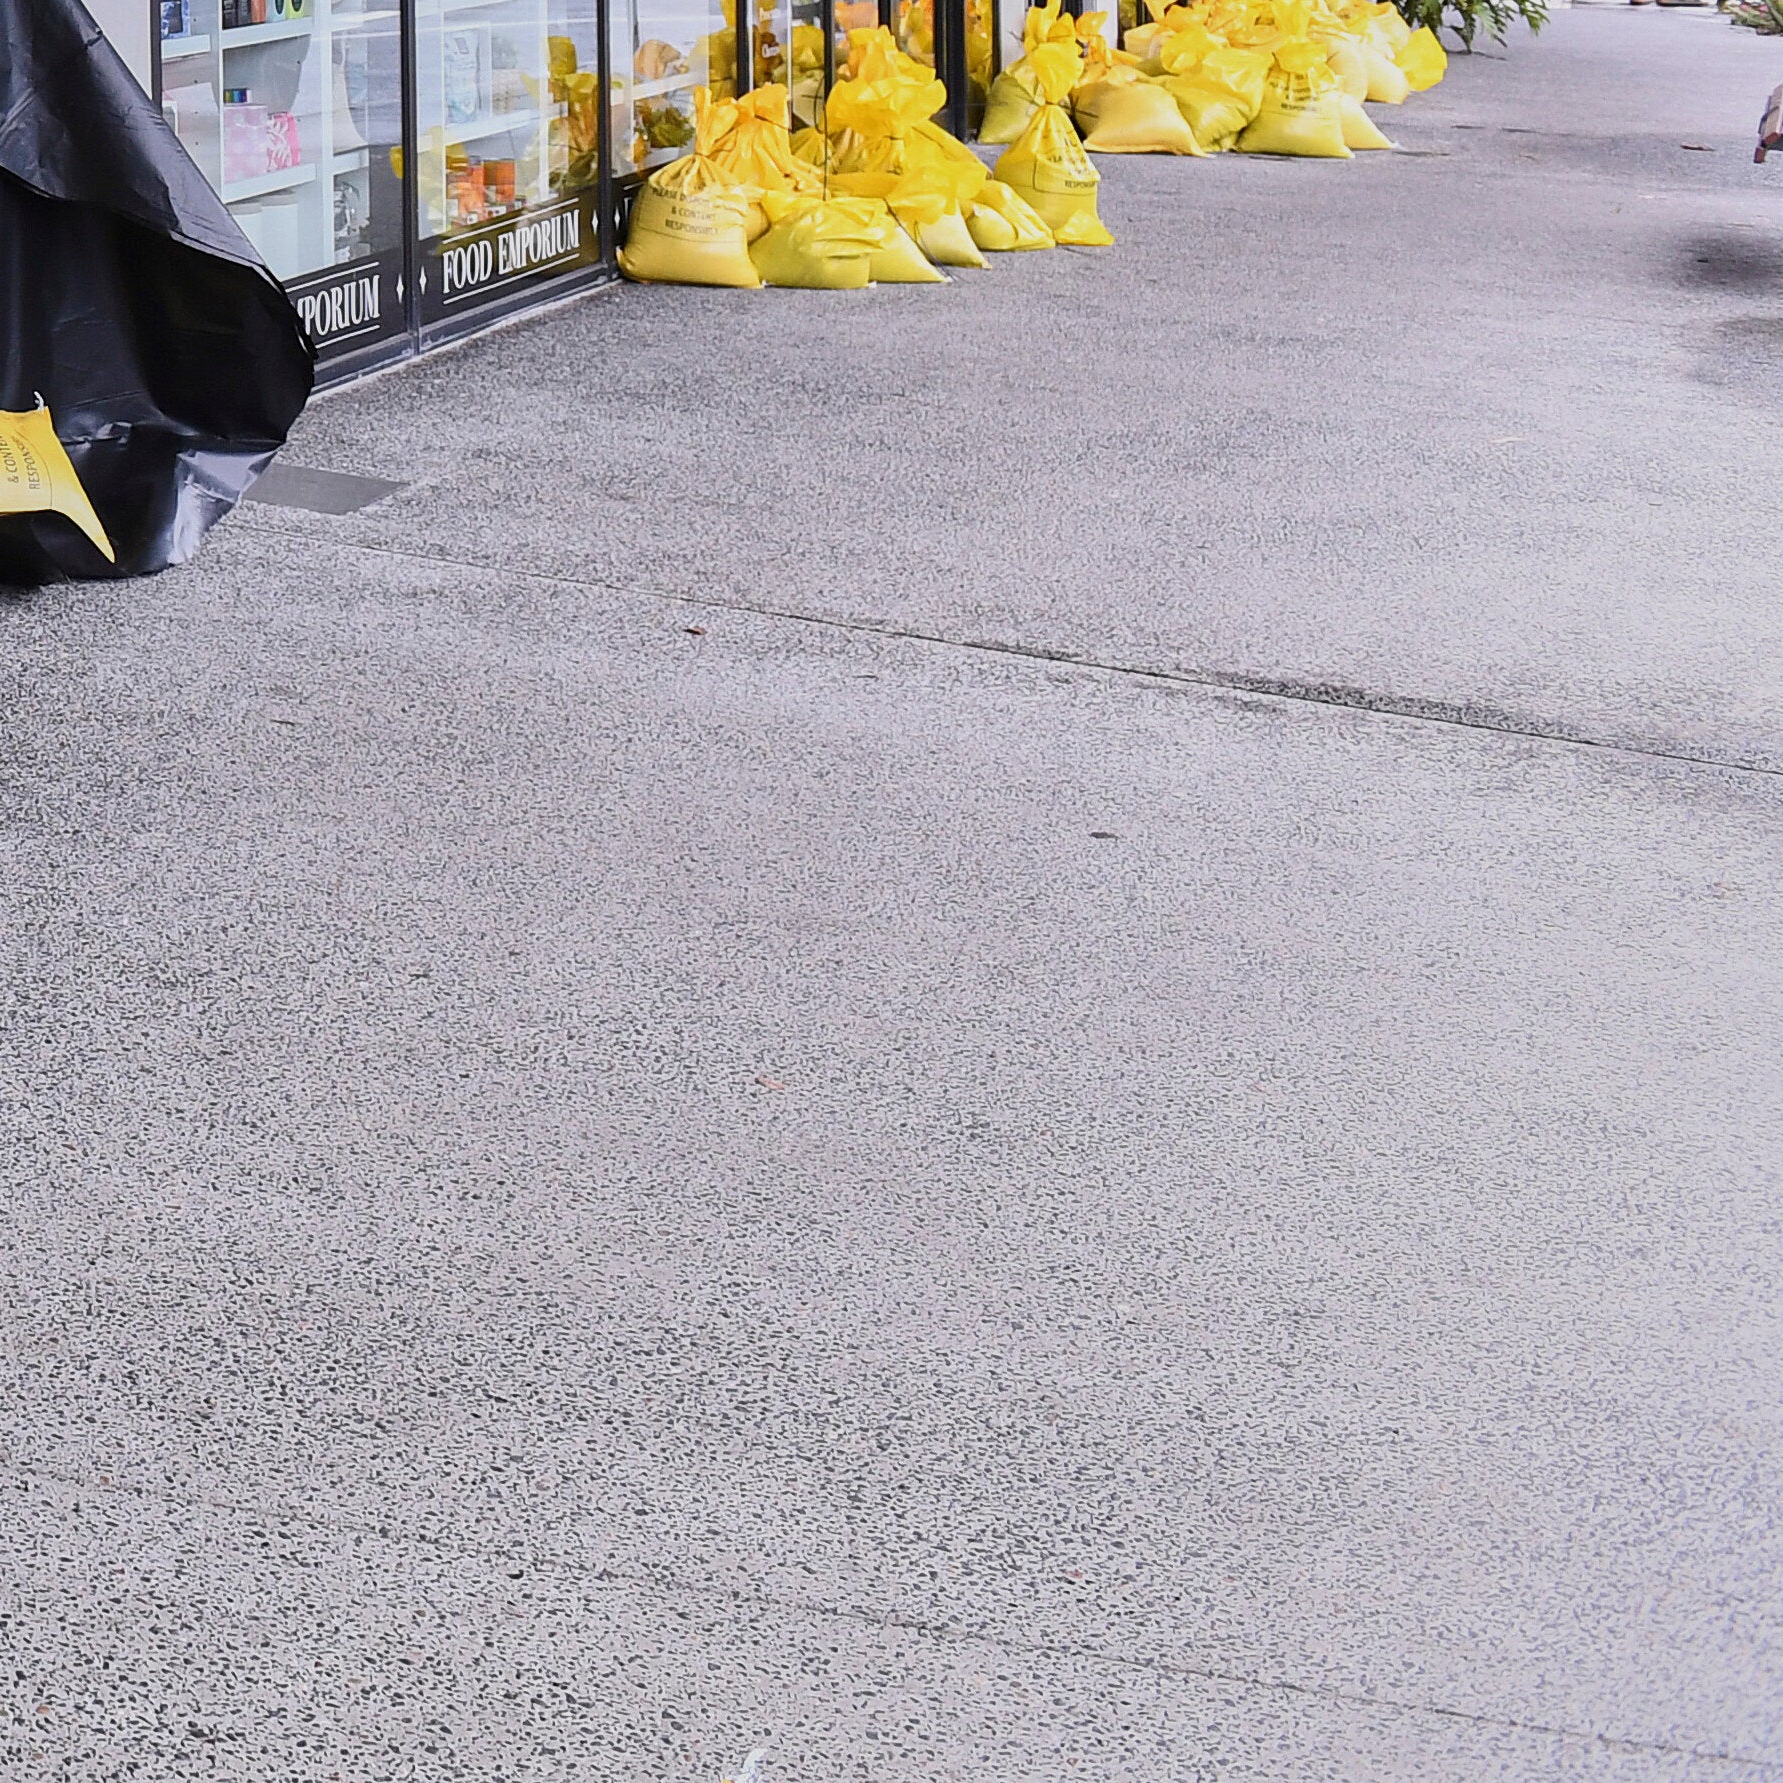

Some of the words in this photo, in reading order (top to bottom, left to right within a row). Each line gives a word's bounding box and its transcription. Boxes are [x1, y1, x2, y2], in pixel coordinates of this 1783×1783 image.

[442, 242, 493, 296] FOOD
[498, 209, 580, 275] EMPORIUM
[297, 274, 380, 337] PORIUM
[8, 475, 20, 484] &
